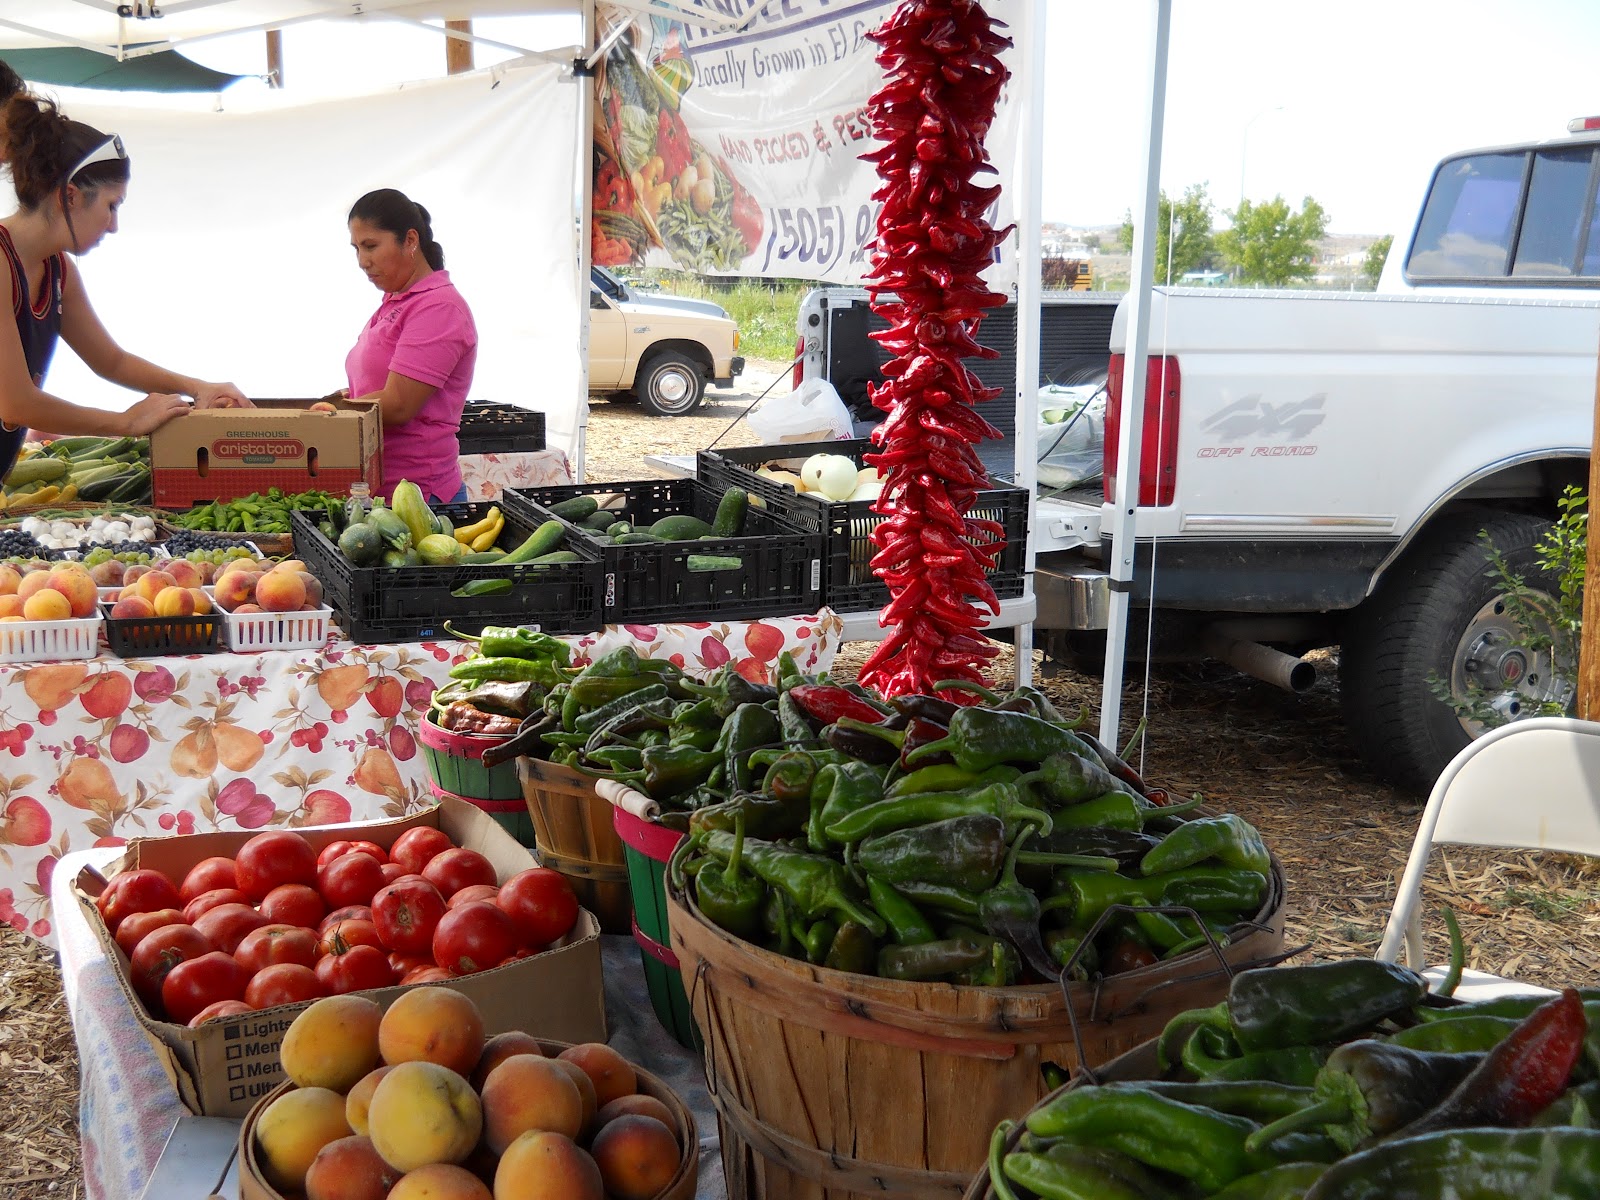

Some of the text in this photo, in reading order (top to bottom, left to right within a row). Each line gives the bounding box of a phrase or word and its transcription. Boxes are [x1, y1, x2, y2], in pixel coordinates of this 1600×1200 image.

[695, 50, 746, 88] Locally
[752, 46, 806, 79] Grown
[804, 37, 827, 67] in
[827, 22, 847, 62] El
[718, 133, 753, 164] HAND
[753, 131, 809, 165] PICKED
[812, 120, 832, 157] &
[761, 206, 845, 277] (505)
[226, 430, 290, 438] GREENHOUSE
[220, 442, 298, 455] aristatom
[1197, 445, 1318, 458] OFF ROAD
[243, 1019, 293, 1037] Lights
[245, 1038, 284, 1057] Men
